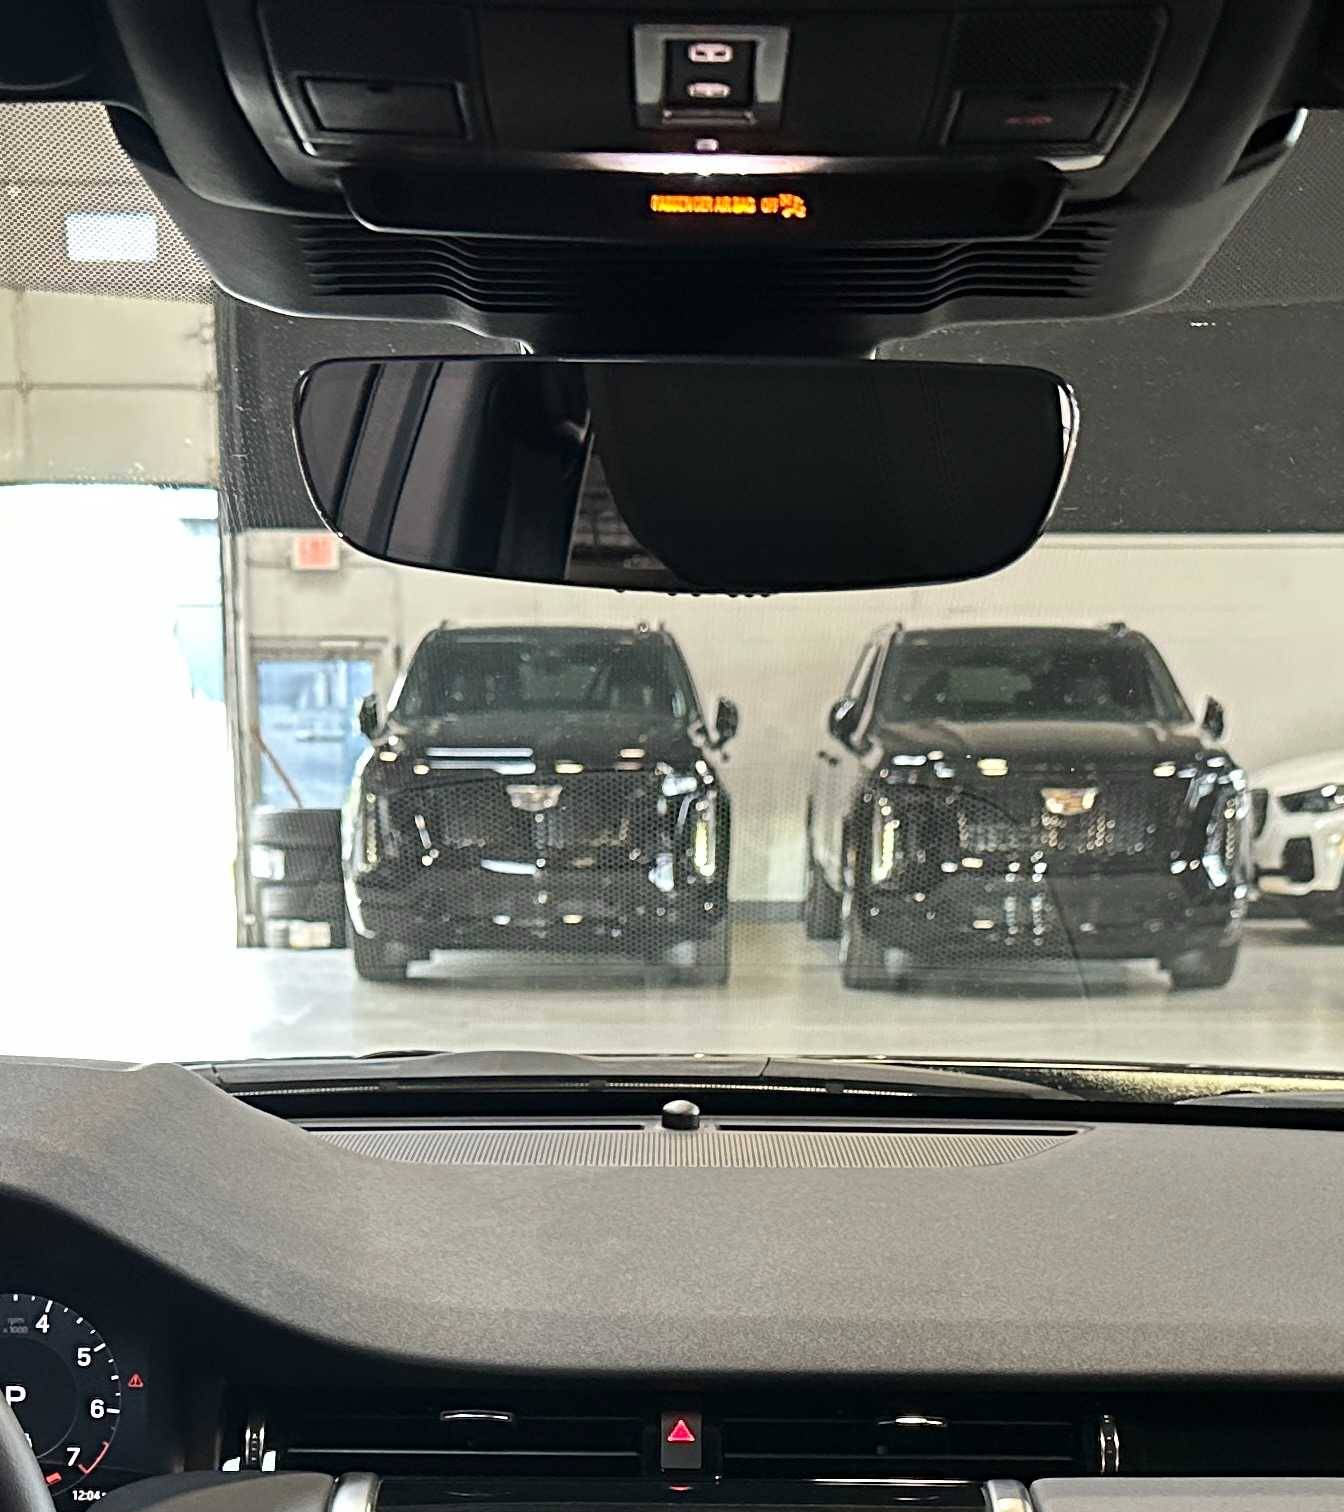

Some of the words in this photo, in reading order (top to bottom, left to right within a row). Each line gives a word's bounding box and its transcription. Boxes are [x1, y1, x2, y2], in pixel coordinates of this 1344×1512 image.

[35, 1314, 50, 1333] 4
[77, 1347, 91, 1366] 5
[90, 1399, 105, 1419] 6
[67, 1447, 81, 1466] 7
[72, 1490, 100, 1501] 12:04
